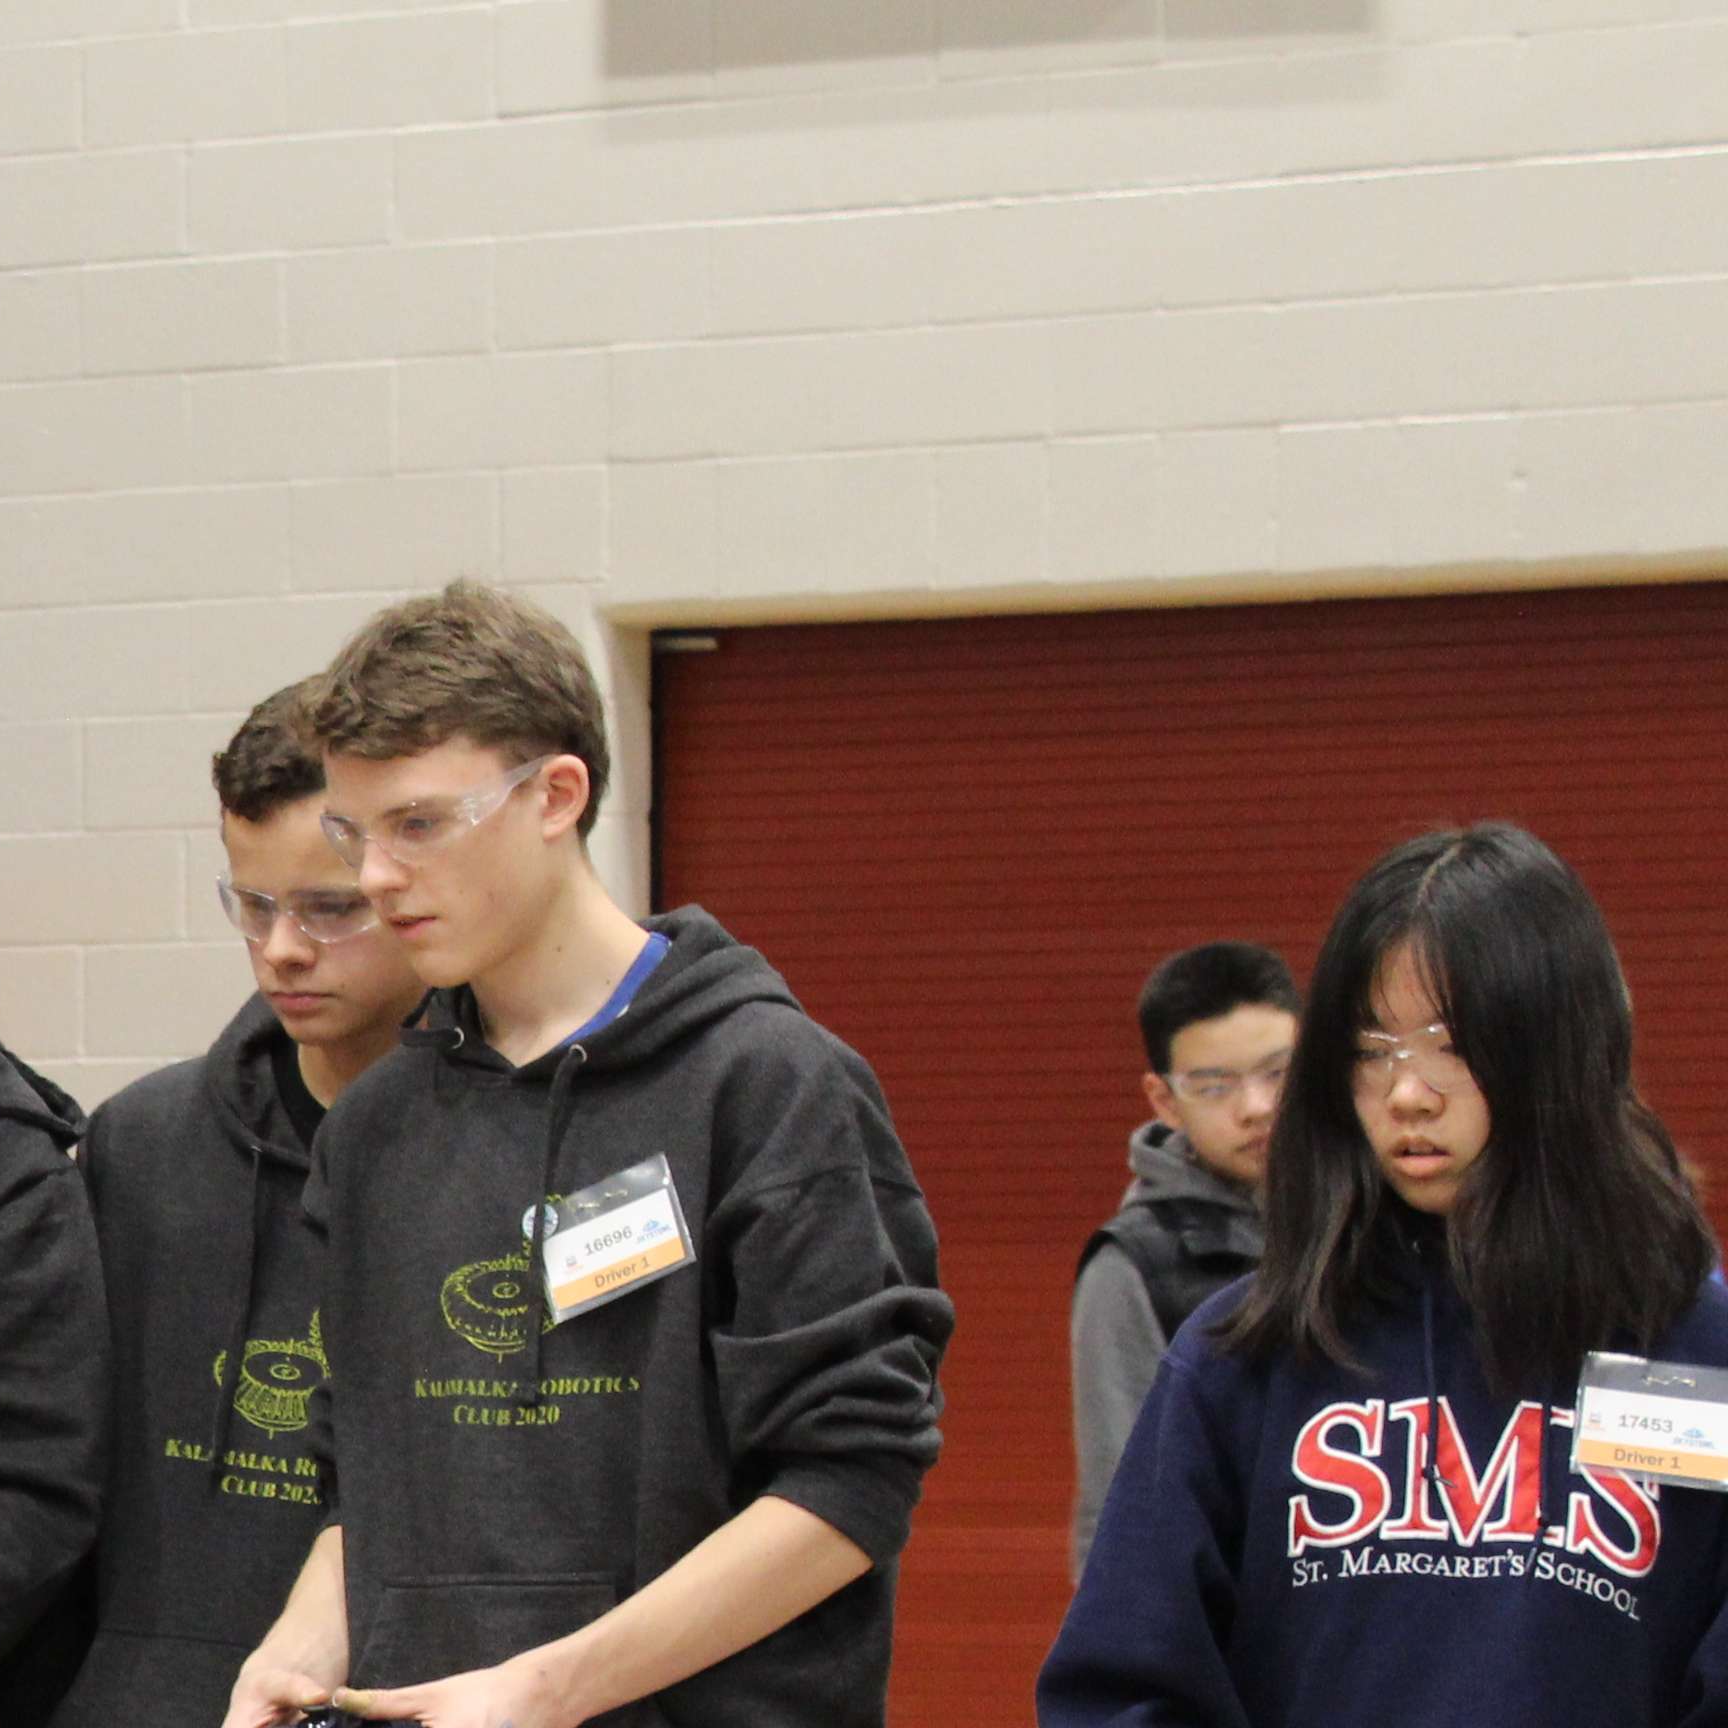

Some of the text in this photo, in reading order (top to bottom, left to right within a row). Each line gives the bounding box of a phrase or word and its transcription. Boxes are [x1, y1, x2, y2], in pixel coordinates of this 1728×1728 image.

[584, 1225, 633, 1256] 16696
[594, 1256, 650, 1288] Driver 1
[539, 1375, 642, 1396] OBOTICS
[1618, 1413, 1674, 1434] 17453
[1614, 1448, 1681, 1470] Driver 1
